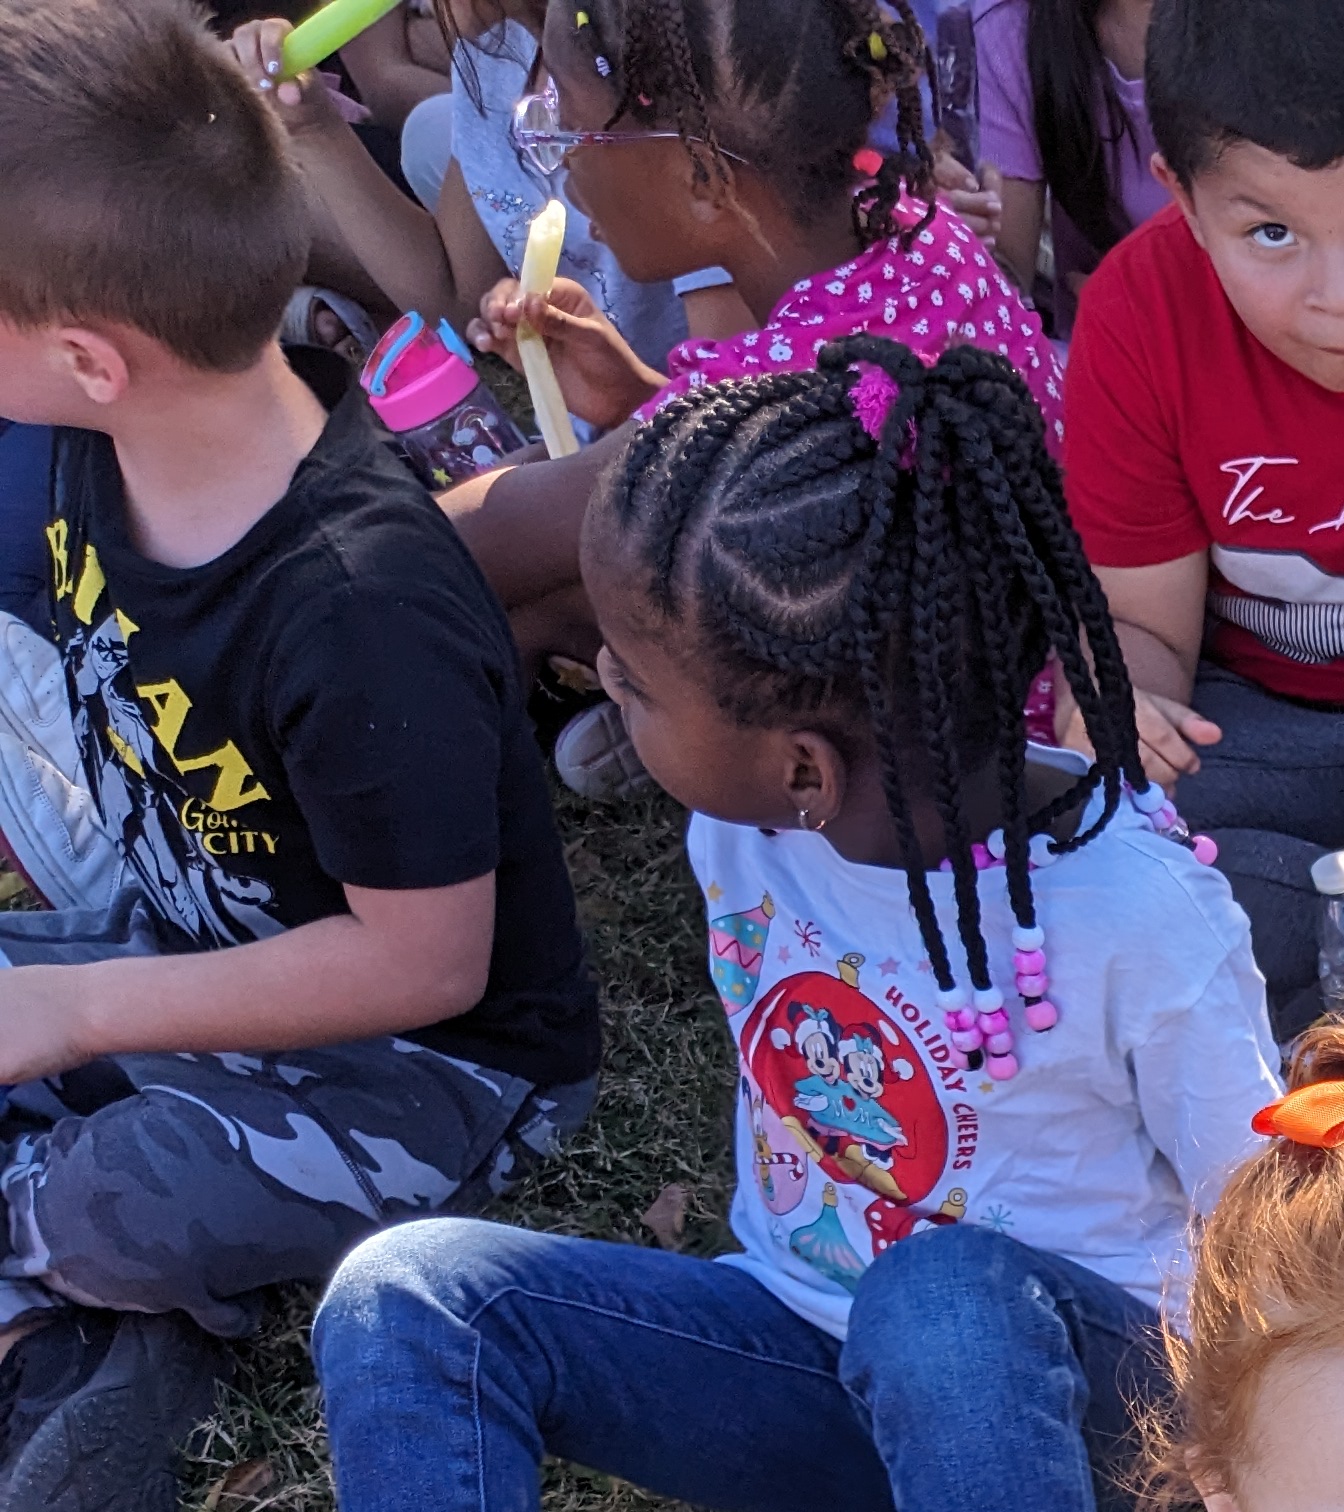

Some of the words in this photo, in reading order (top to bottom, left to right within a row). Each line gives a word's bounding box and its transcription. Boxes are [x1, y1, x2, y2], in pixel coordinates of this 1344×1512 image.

[1219, 456, 1298, 525] The
[203, 831, 280, 854] CITY
[885, 985, 968, 1094] HOLIDAY
[952, 1102, 979, 1171] CHEERS
